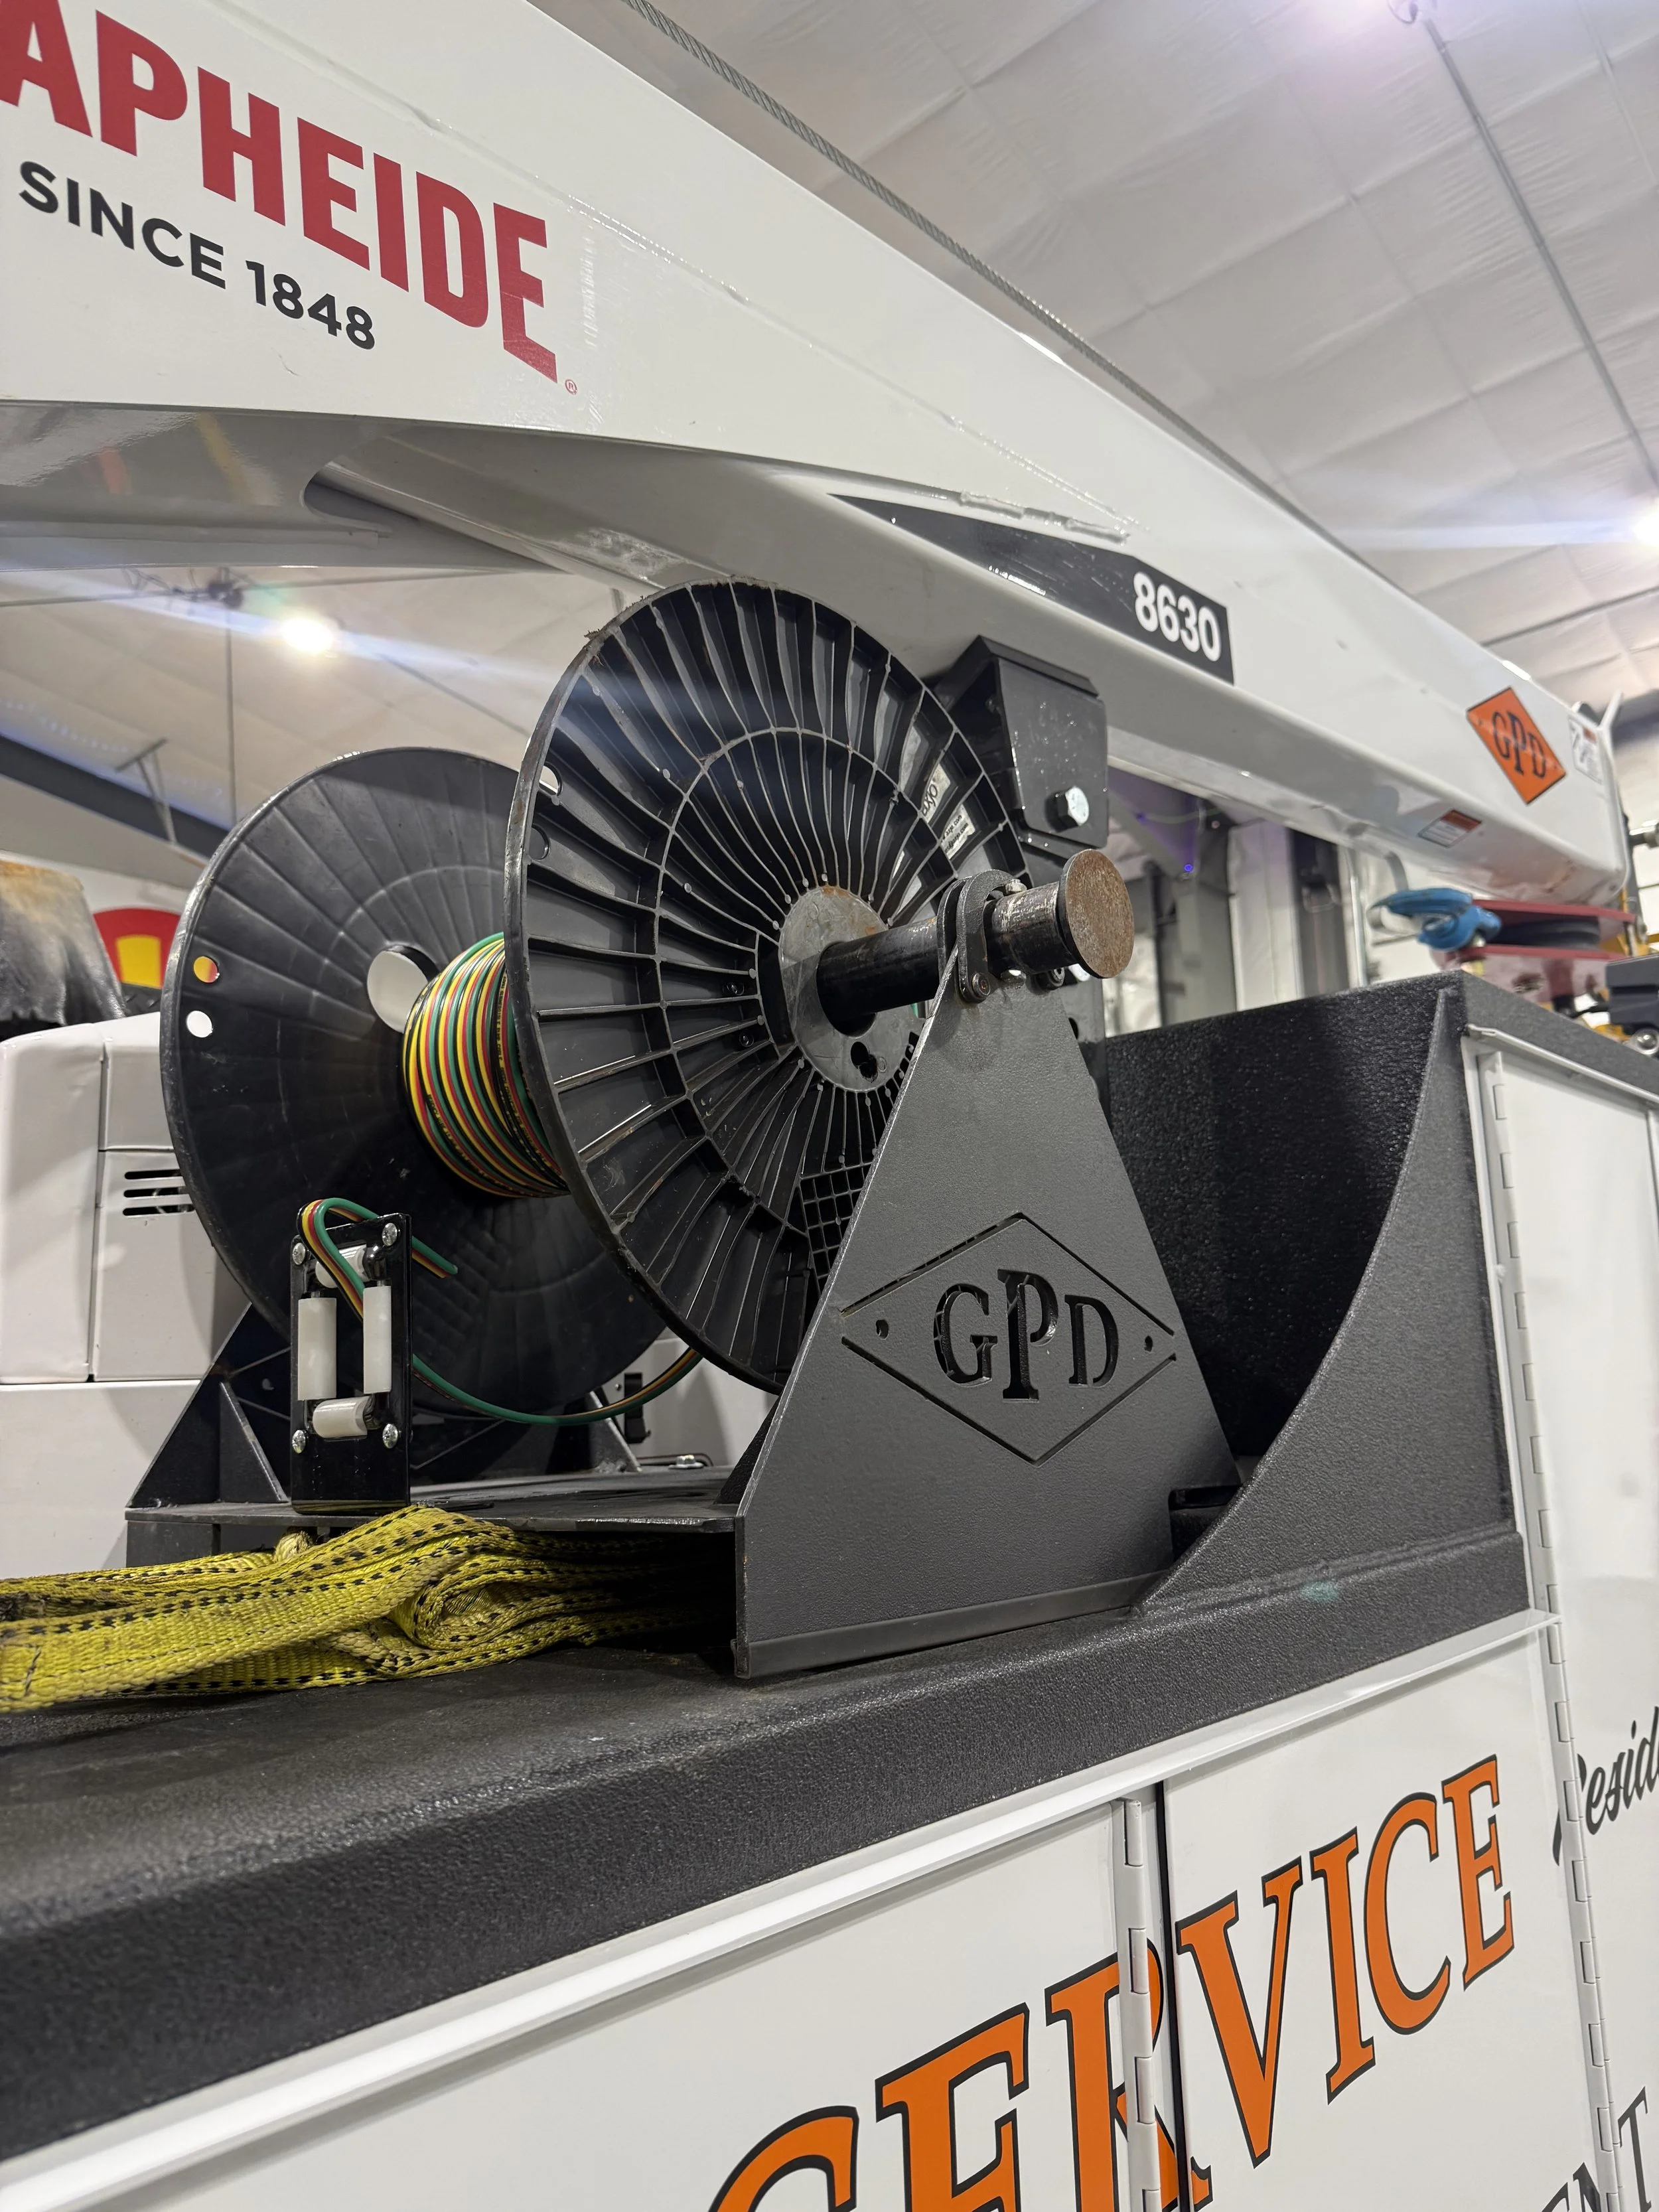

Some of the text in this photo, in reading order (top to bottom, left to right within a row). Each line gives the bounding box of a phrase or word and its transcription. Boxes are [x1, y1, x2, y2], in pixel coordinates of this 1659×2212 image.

[19, 161, 375, 350] SINCE 1848
[1133, 572, 1221, 662] 8630
[1492, 710, 1546, 779] GPD
[933, 1268, 1119, 1403] GPD
[1553, 1706, 1659, 1867] esid
